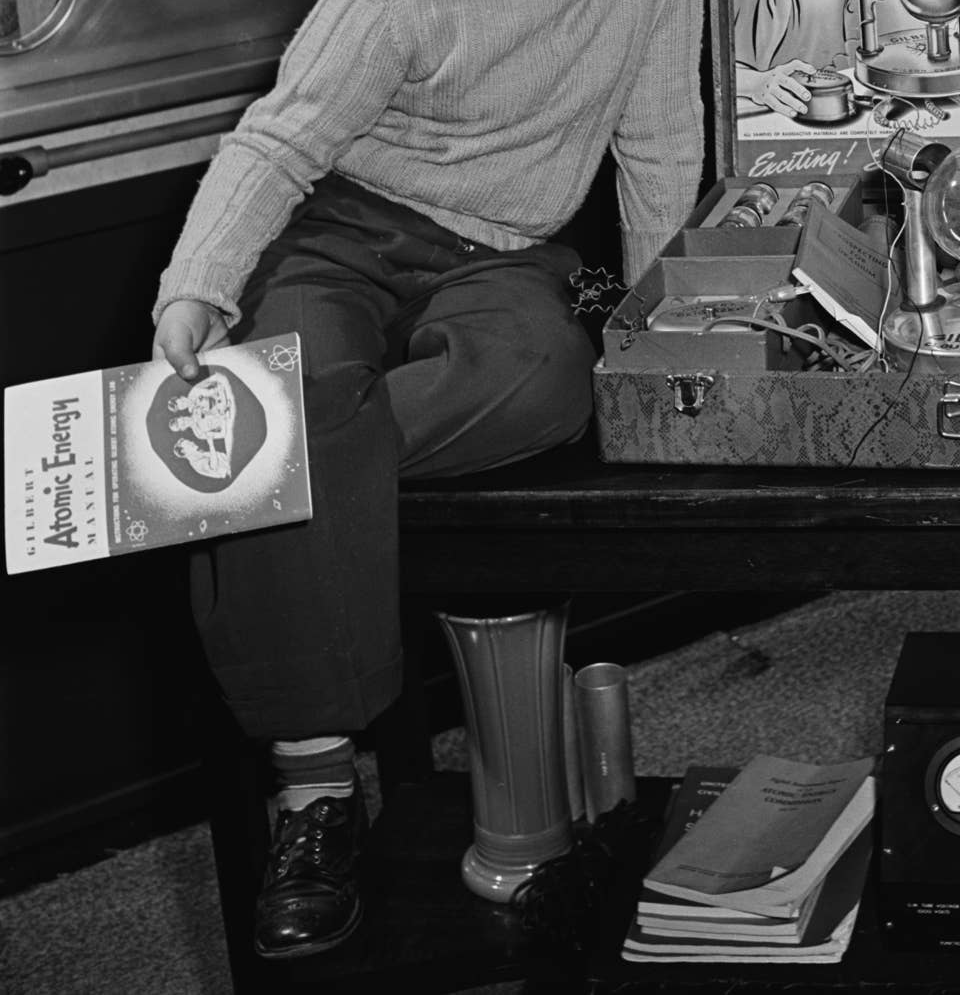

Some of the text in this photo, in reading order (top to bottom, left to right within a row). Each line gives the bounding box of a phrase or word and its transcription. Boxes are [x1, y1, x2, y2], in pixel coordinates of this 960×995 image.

[748, 141, 858, 177] Exciting!
[24, 468, 36, 556] GILBERT
[41, 397, 81, 549] Atomic Energy
[84, 456, 97, 544] MANUAL
